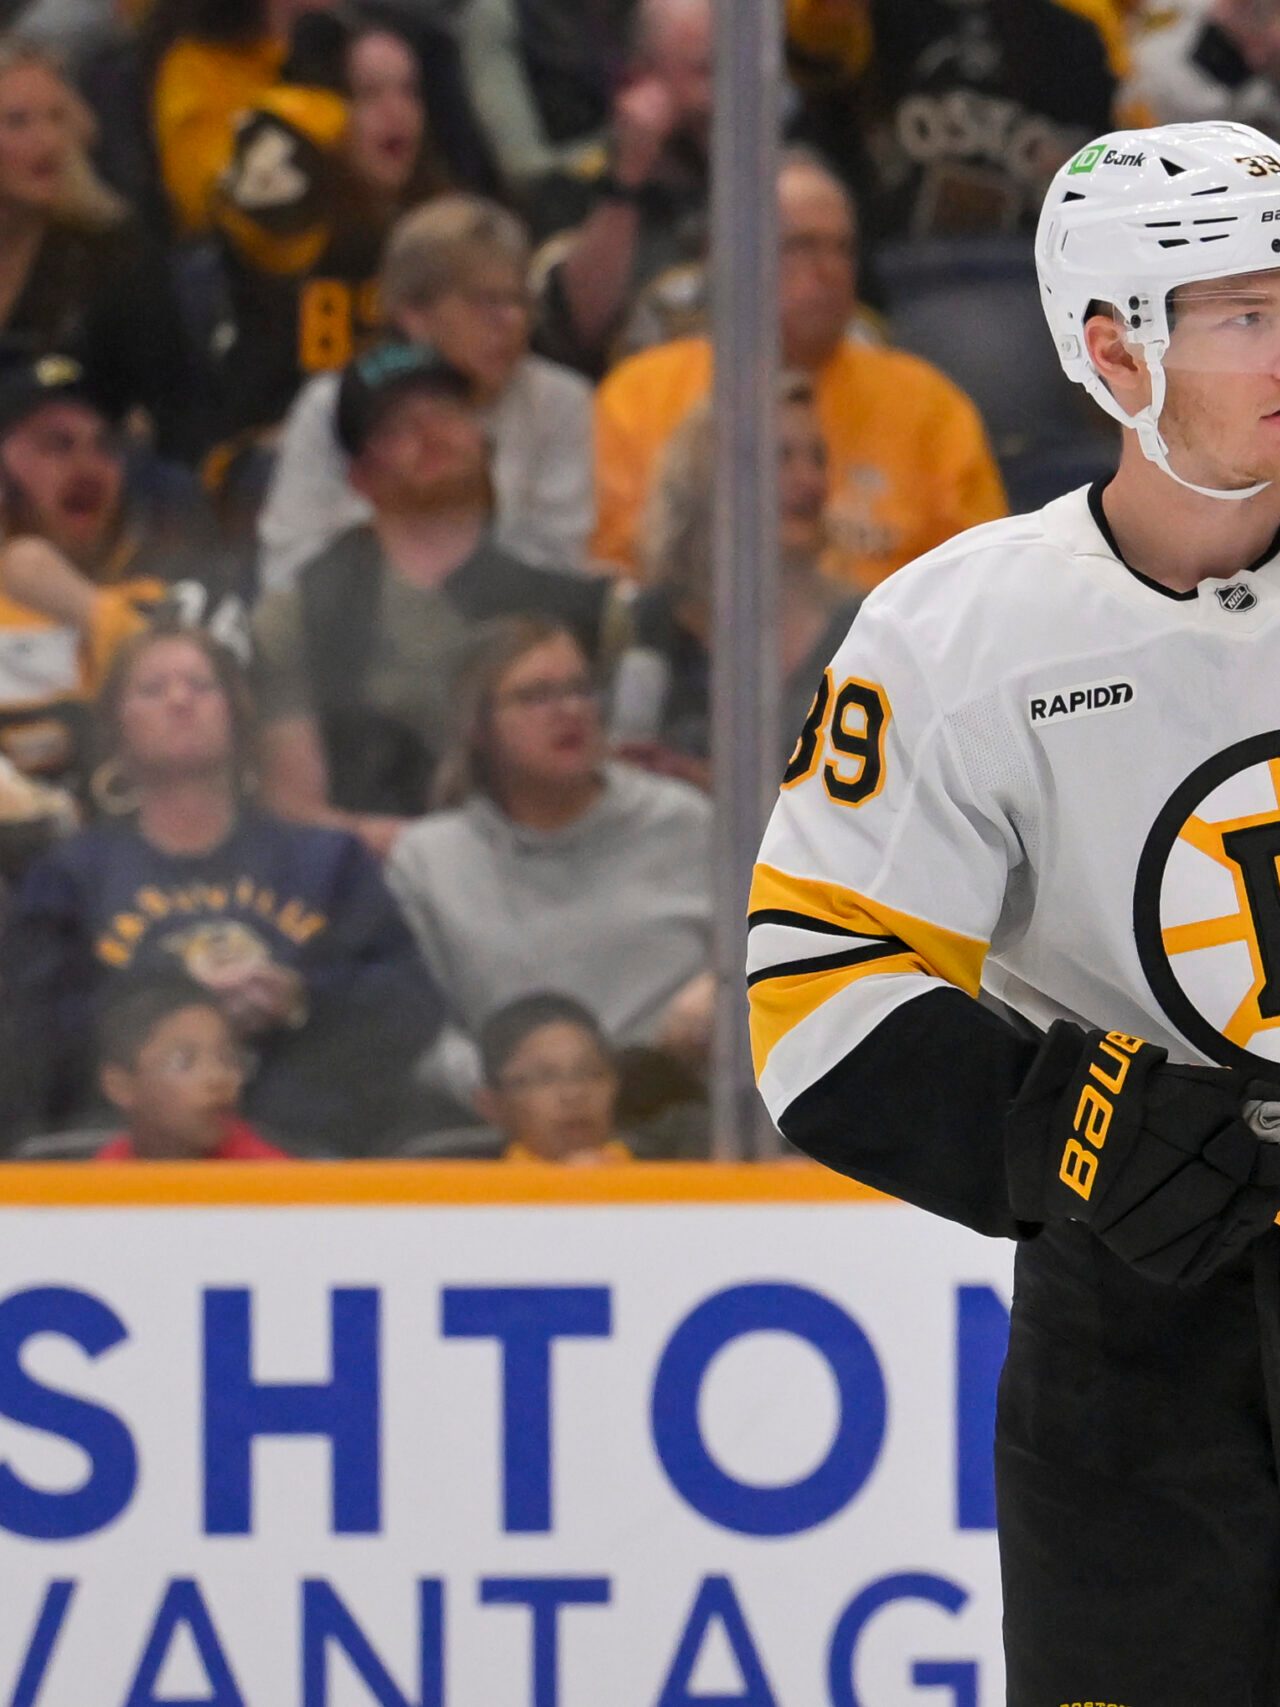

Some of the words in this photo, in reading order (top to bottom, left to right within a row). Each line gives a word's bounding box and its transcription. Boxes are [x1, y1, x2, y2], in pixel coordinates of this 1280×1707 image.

[1103, 149, 1146, 168] Bank
[1227, 589, 1246, 609] NHL
[1030, 682, 1134, 721] RAPID7
